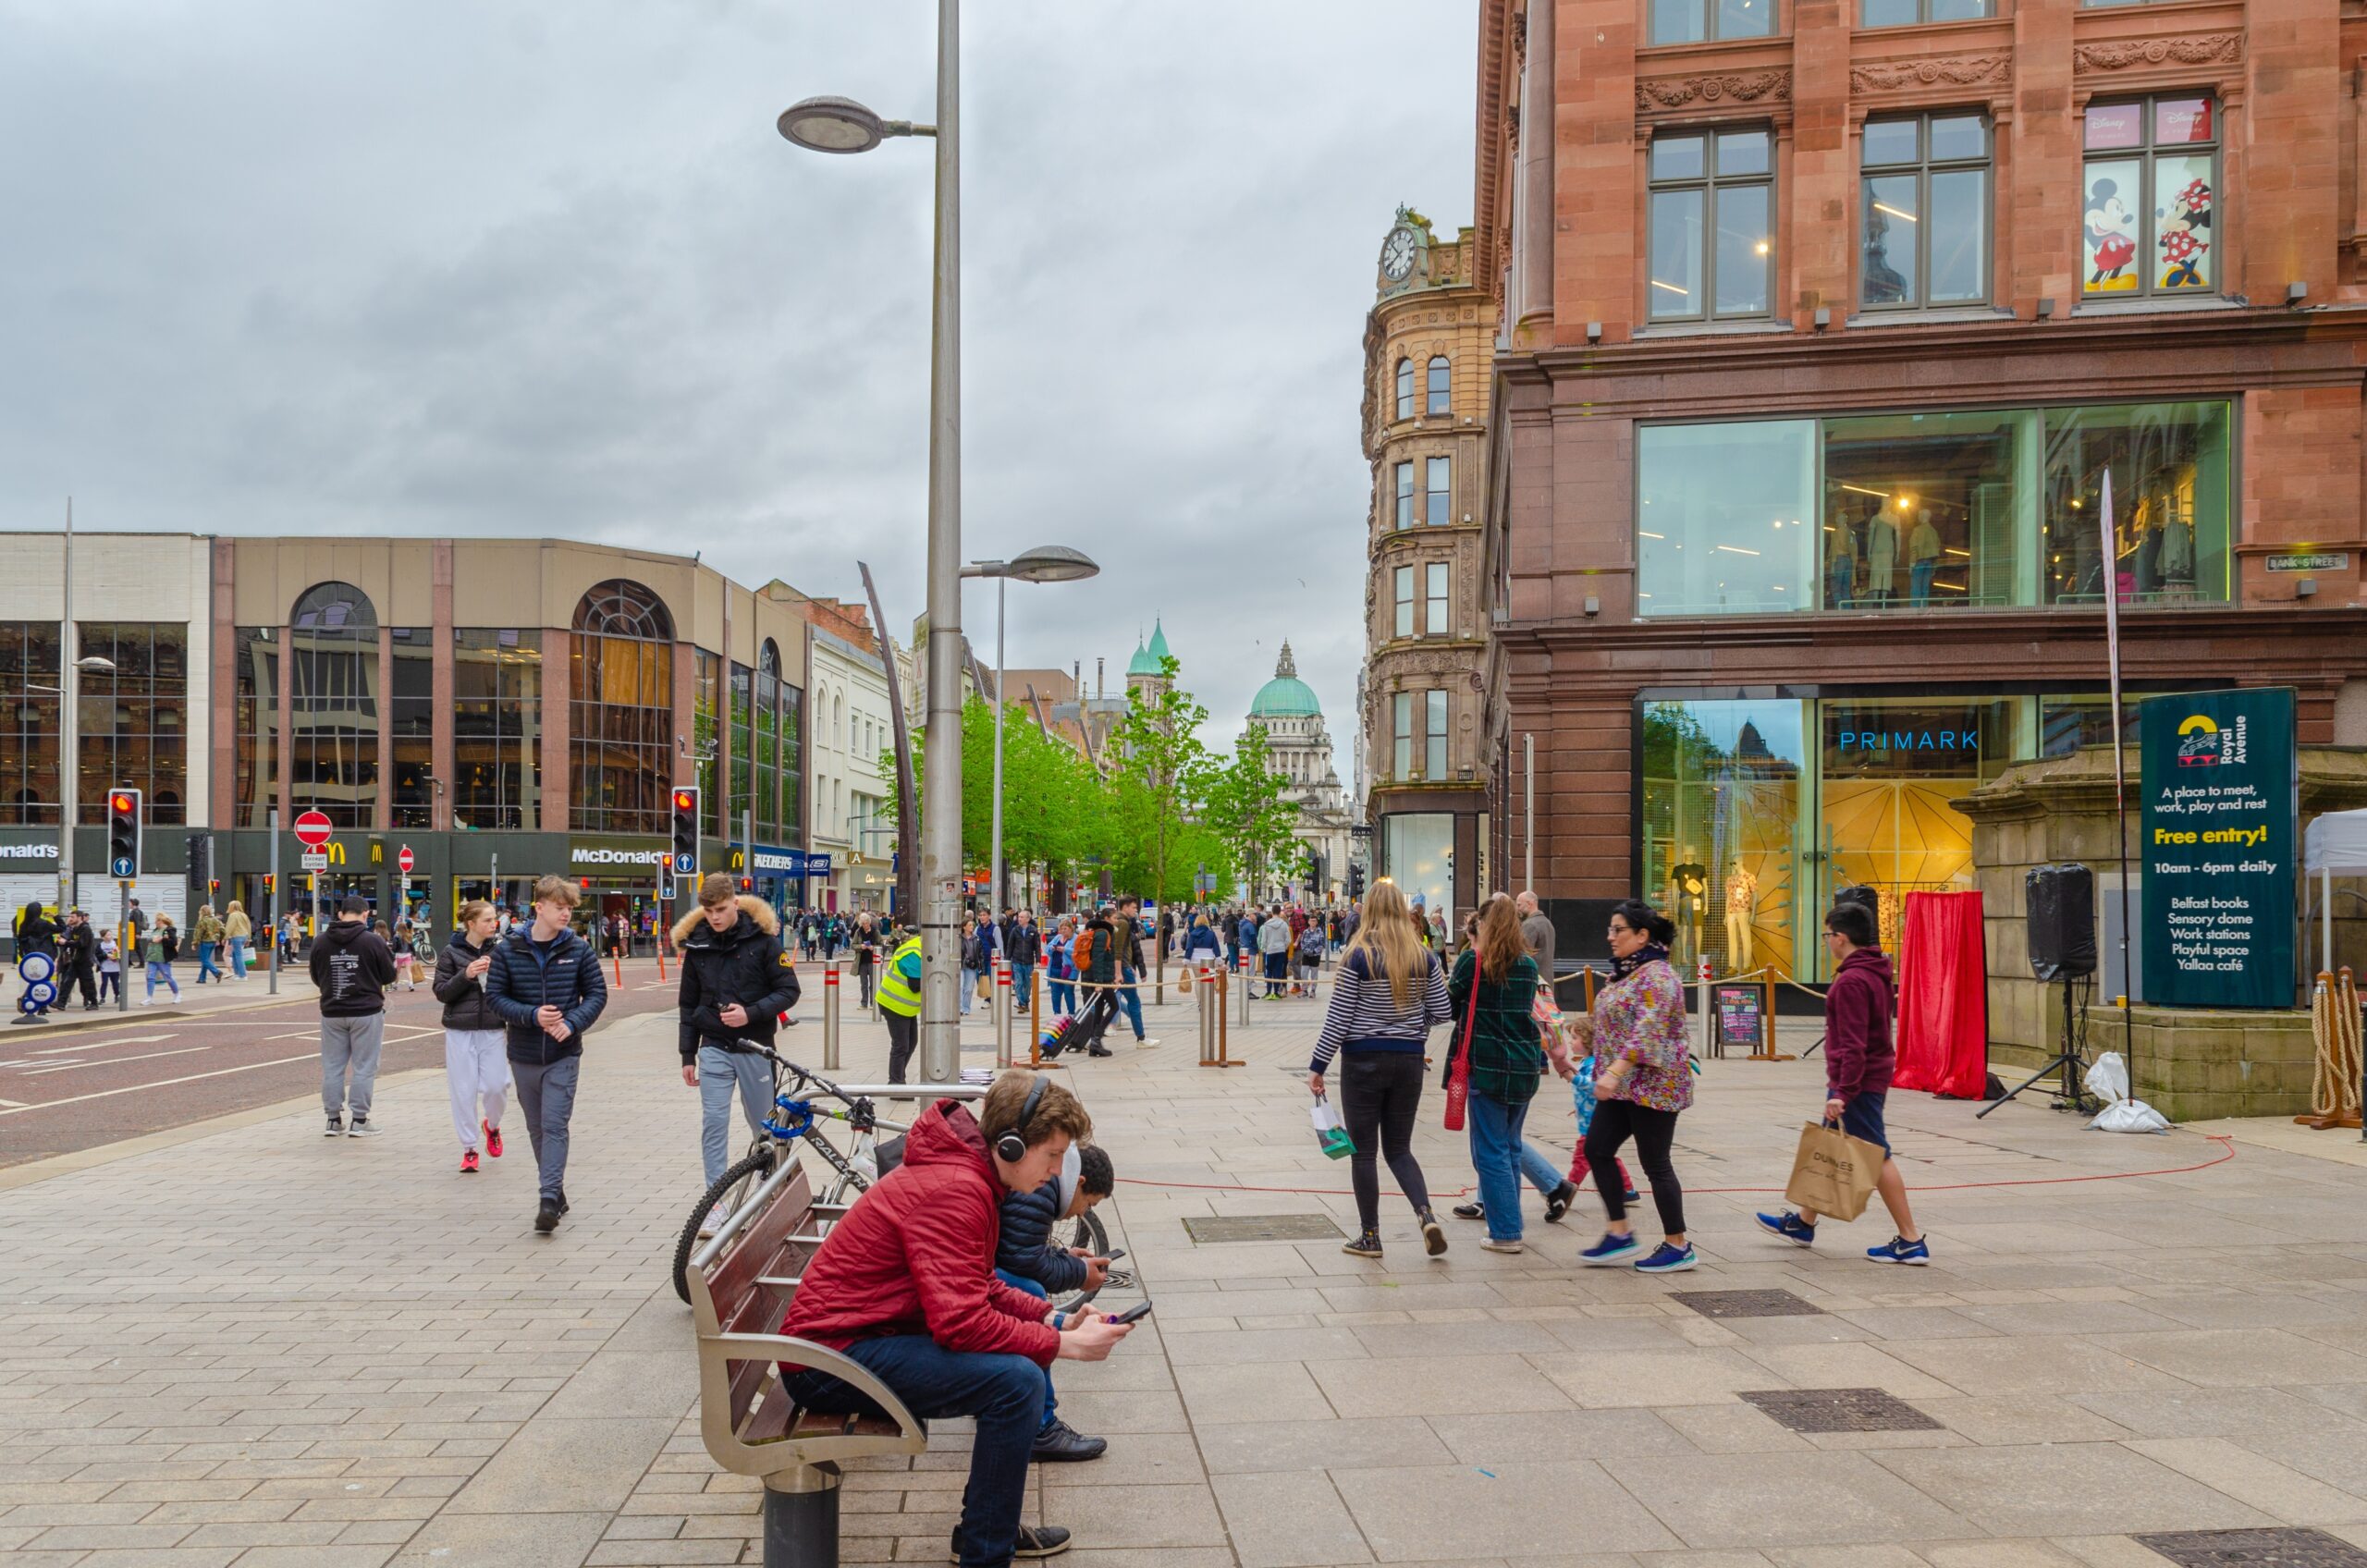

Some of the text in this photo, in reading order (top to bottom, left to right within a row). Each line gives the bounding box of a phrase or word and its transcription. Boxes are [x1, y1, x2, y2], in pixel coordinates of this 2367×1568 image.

[2164, 112, 2202, 124] Disney
[2270, 557, 2340, 568] BANK STREET
[1839, 730, 1978, 751] PRIMARK
[2220, 729, 2236, 764] Royal
[2234, 715, 2247, 764] Avenue
[2162, 784, 2257, 801] A place to meet,
[2154, 798, 2267, 815] work, play and rest
[2154, 825, 2267, 846] Free entry!
[0, 844, 59, 858] nald's
[851, 852, 862, 864] A
[2154, 862, 2190, 874] 10am
[2202, 862, 2235, 876] 6pm
[2238, 860, 2276, 875] daily
[2171, 896, 2249, 909] Belfast books
[2167, 912, 2253, 926] Sensory dome
[2170, 927, 2250, 940] Work stations
[2172, 942, 2249, 957] Playful space
[2177, 958, 2243, 972] Yallaa café
